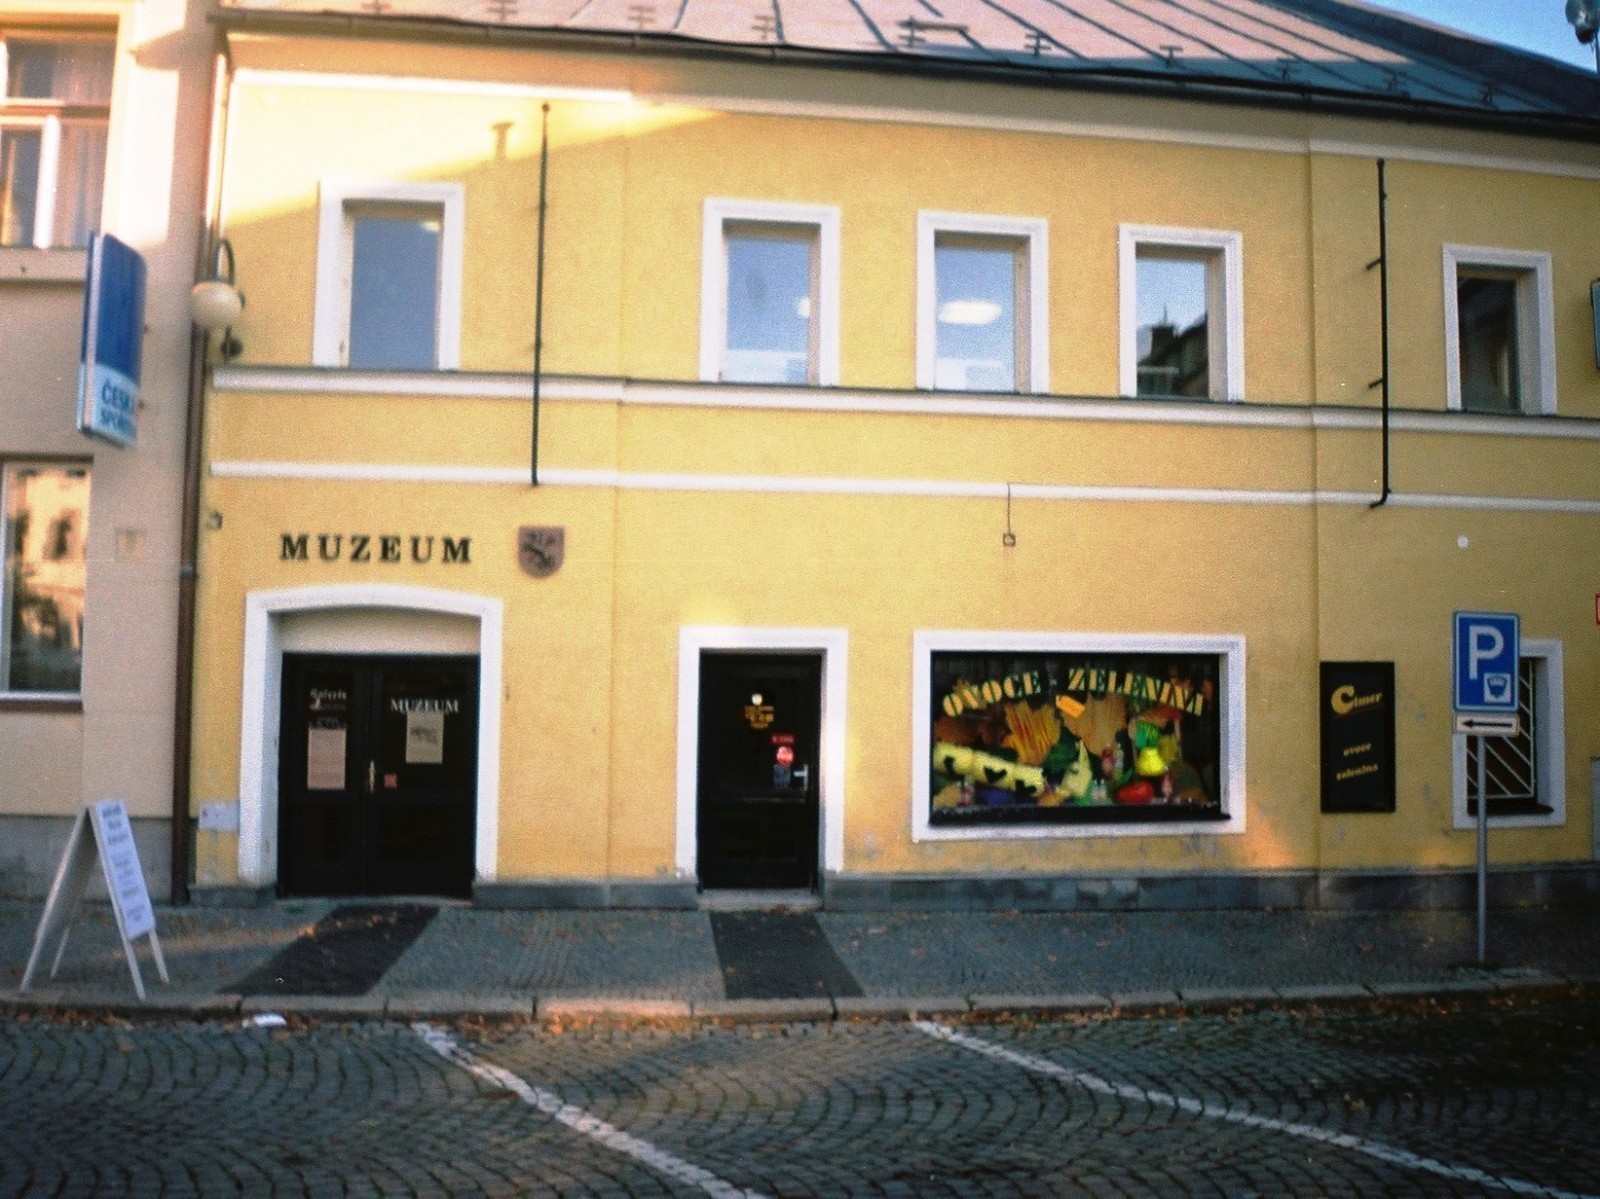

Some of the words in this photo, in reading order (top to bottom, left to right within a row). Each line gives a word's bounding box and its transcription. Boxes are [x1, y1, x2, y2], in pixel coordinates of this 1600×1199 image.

[279, 532, 472, 564] MUZEUM
[1469, 625, 1504, 680] P
[391, 698, 459, 714] MUZEUM
[943, 671, 1041, 717] OVOCE
[1068, 667, 1204, 717] ZELENINA
